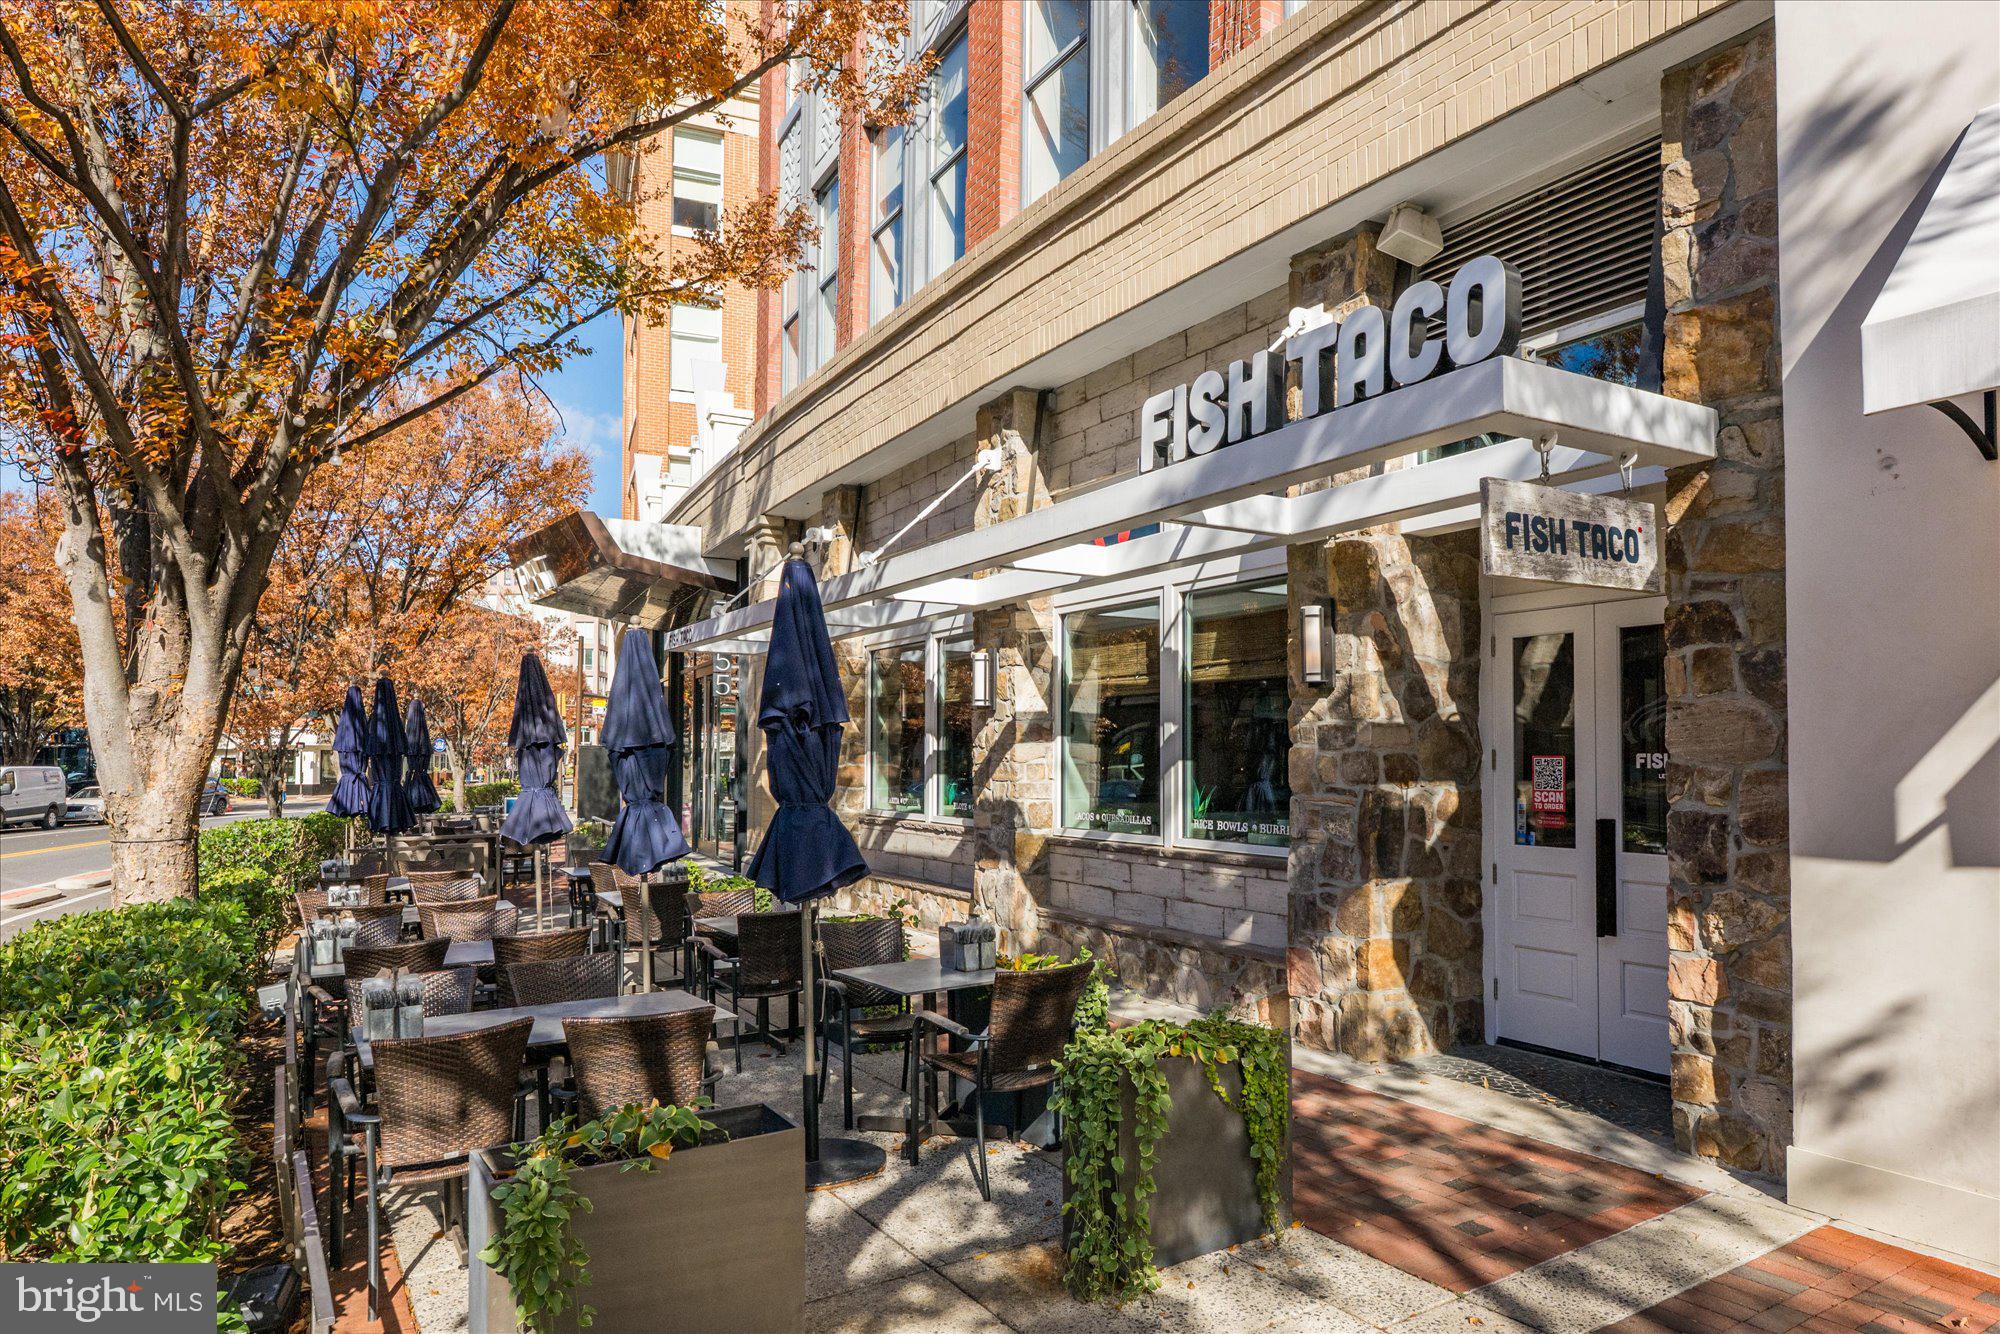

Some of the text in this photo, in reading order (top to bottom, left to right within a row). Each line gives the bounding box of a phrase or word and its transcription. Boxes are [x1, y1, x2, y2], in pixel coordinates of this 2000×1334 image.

[1140, 254, 1507, 473] FISH TACO
[1505, 511, 1640, 564] FISH TACO
[1534, 791, 1564, 803] SCAN
[1543, 802, 1564, 810] ORDER
[1101, 812, 1152, 826] QUESADILLAS
[1193, 818, 1214, 830] RICE
[1216, 820, 1248, 833] BOWLS
